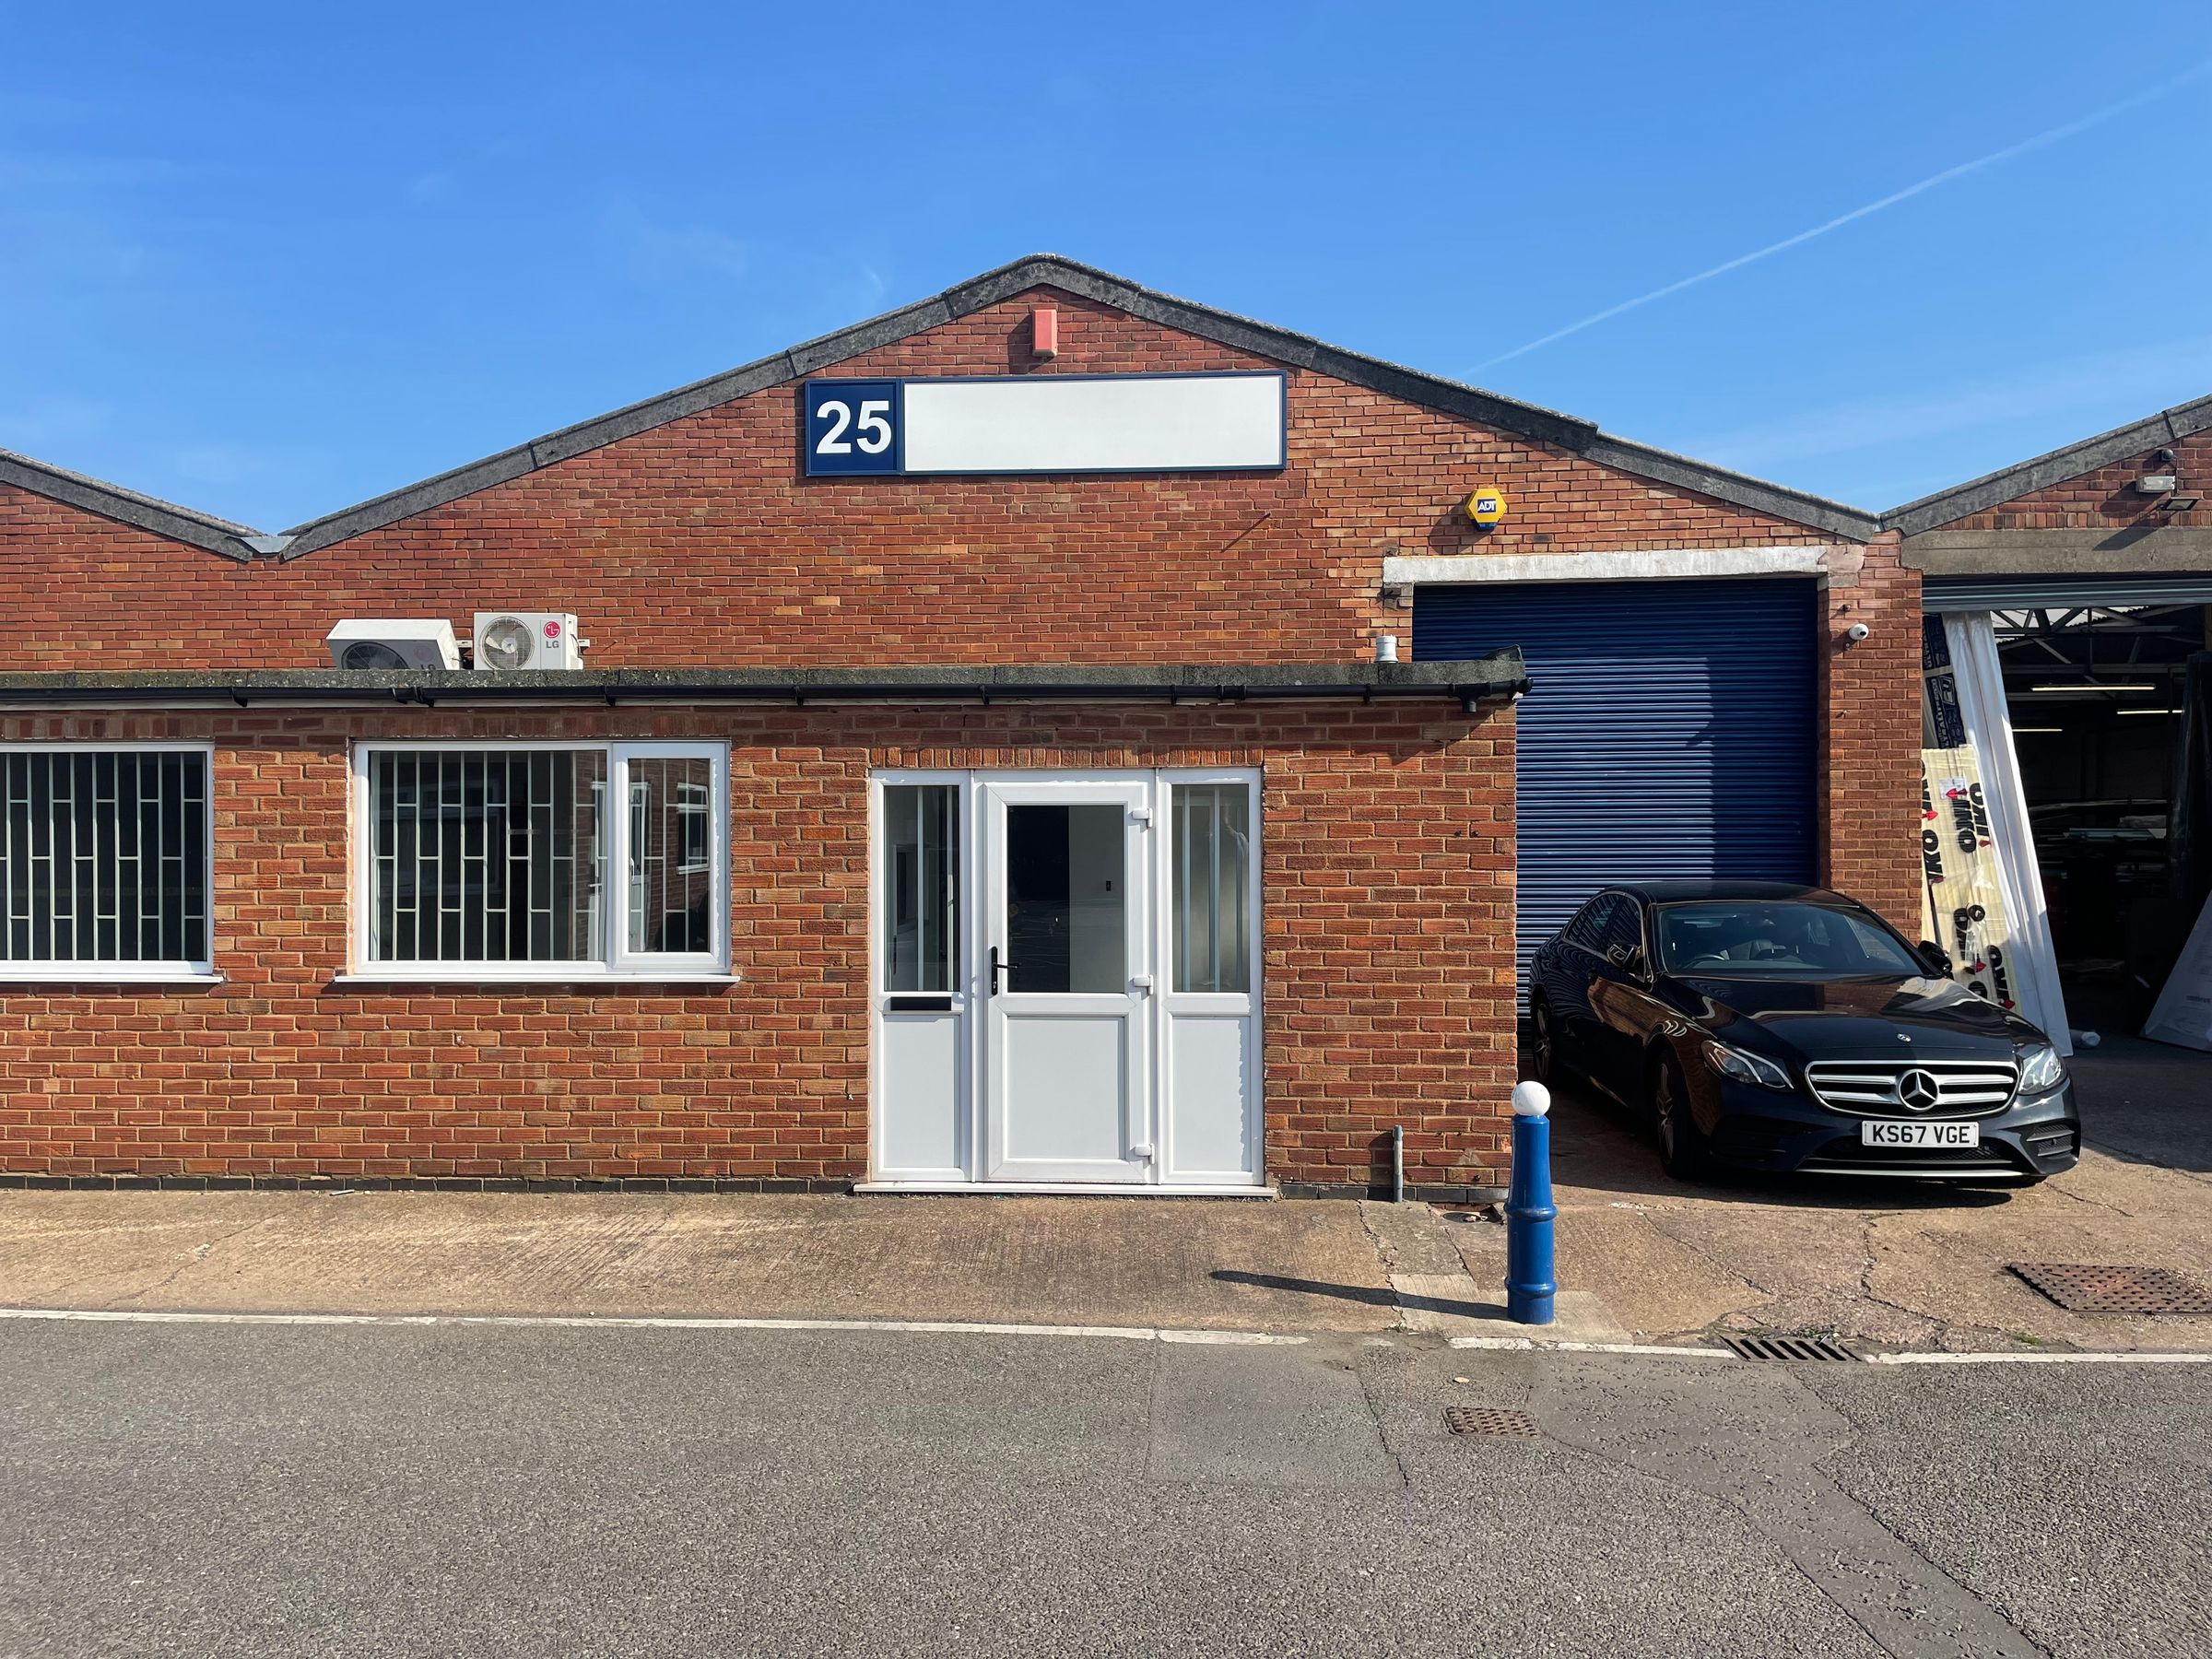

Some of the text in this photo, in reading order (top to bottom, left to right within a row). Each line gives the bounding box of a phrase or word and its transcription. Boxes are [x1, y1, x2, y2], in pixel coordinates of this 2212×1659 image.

[816, 400, 892, 454] 25
[1477, 500, 1497, 512] ADT
[546, 640, 559, 649] LG
[1872, 1124, 1971, 1144] KS67 VGE
